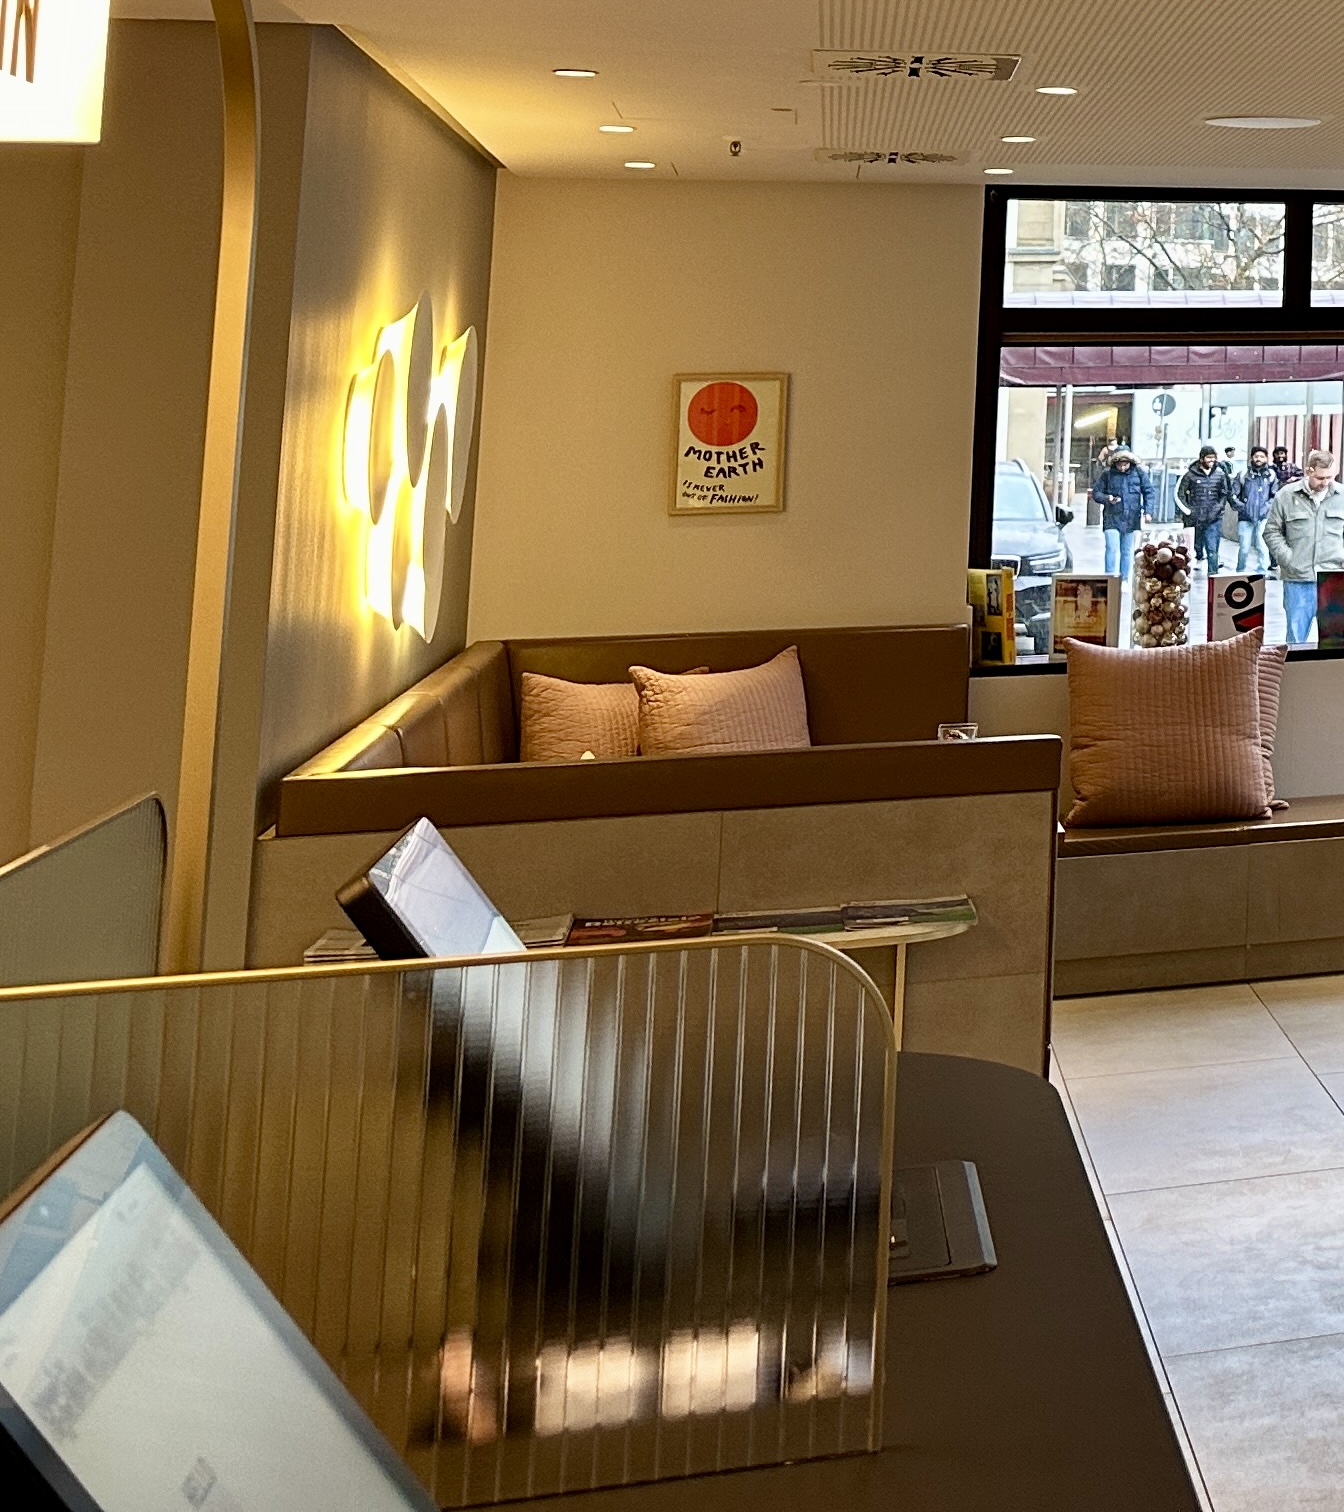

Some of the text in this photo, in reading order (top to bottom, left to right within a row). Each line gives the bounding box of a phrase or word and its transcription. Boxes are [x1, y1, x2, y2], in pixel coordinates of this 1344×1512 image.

[684, 441, 766, 465] MOTHER
[703, 457, 764, 479] EARTH
[682, 479, 725, 493] IS NEVER
[709, 493, 759, 505] FASHION!
